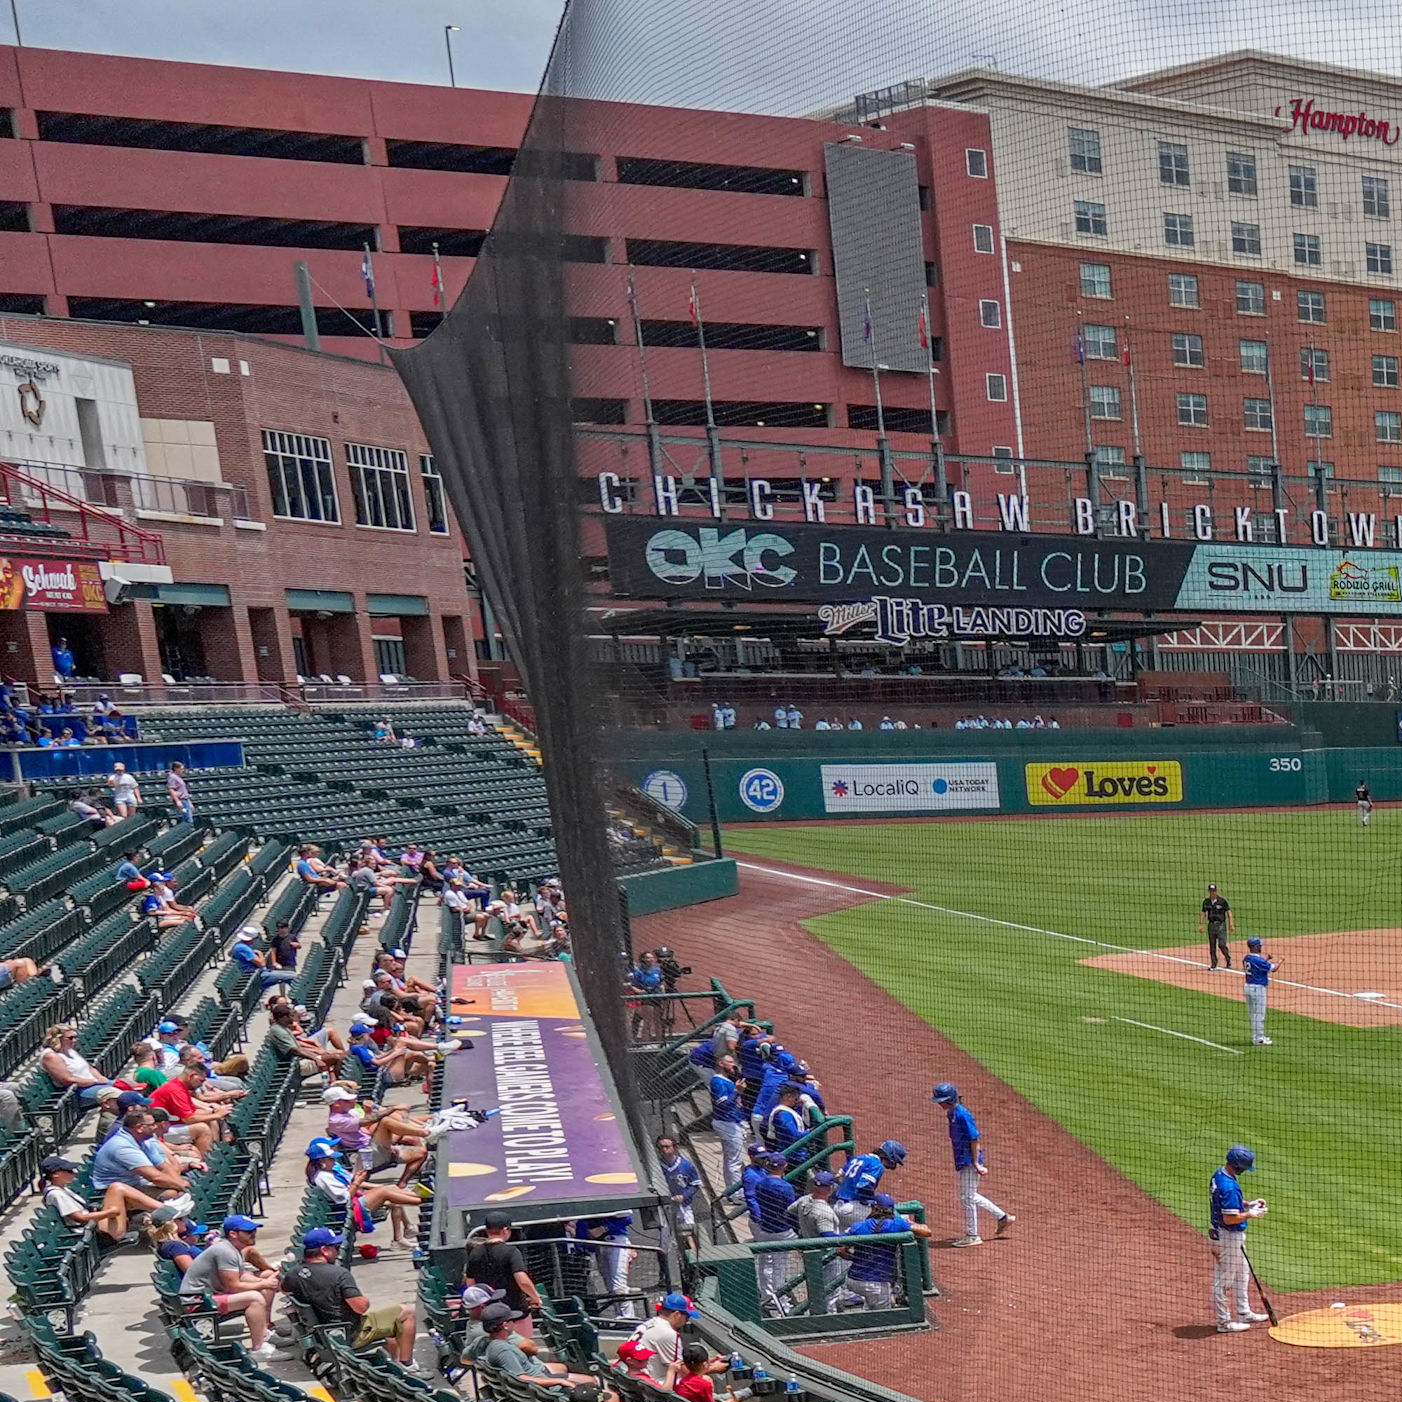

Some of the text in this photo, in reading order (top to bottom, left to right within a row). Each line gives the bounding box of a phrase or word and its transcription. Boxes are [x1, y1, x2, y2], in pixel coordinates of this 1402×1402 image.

[1276, 98, 1400, 145] Hampton
[599, 472, 1030, 532] CHICKASAW
[646, 528, 1146, 593] OKC BASEBALL CLUB
[1208, 562, 1307, 592] SNU
[1334, 580, 1395, 591] RODIZIO GRILL
[818, 597, 1086, 646] Miller Lite LANDING
[1269, 758, 1301, 771] 350
[663, 782, 667, 801] 1
[749, 779, 775, 799] 42
[854, 779, 919, 797] LocaliQ
[491, 1020, 543, 1047] WHERE
[494, 1046, 546, 1064] REEL
[495, 1063, 555, 1101] GAMERS
[500, 1100, 562, 1132] COME
[503, 1129, 566, 1147] TO
[505, 1147, 574, 1184] PLAY!
